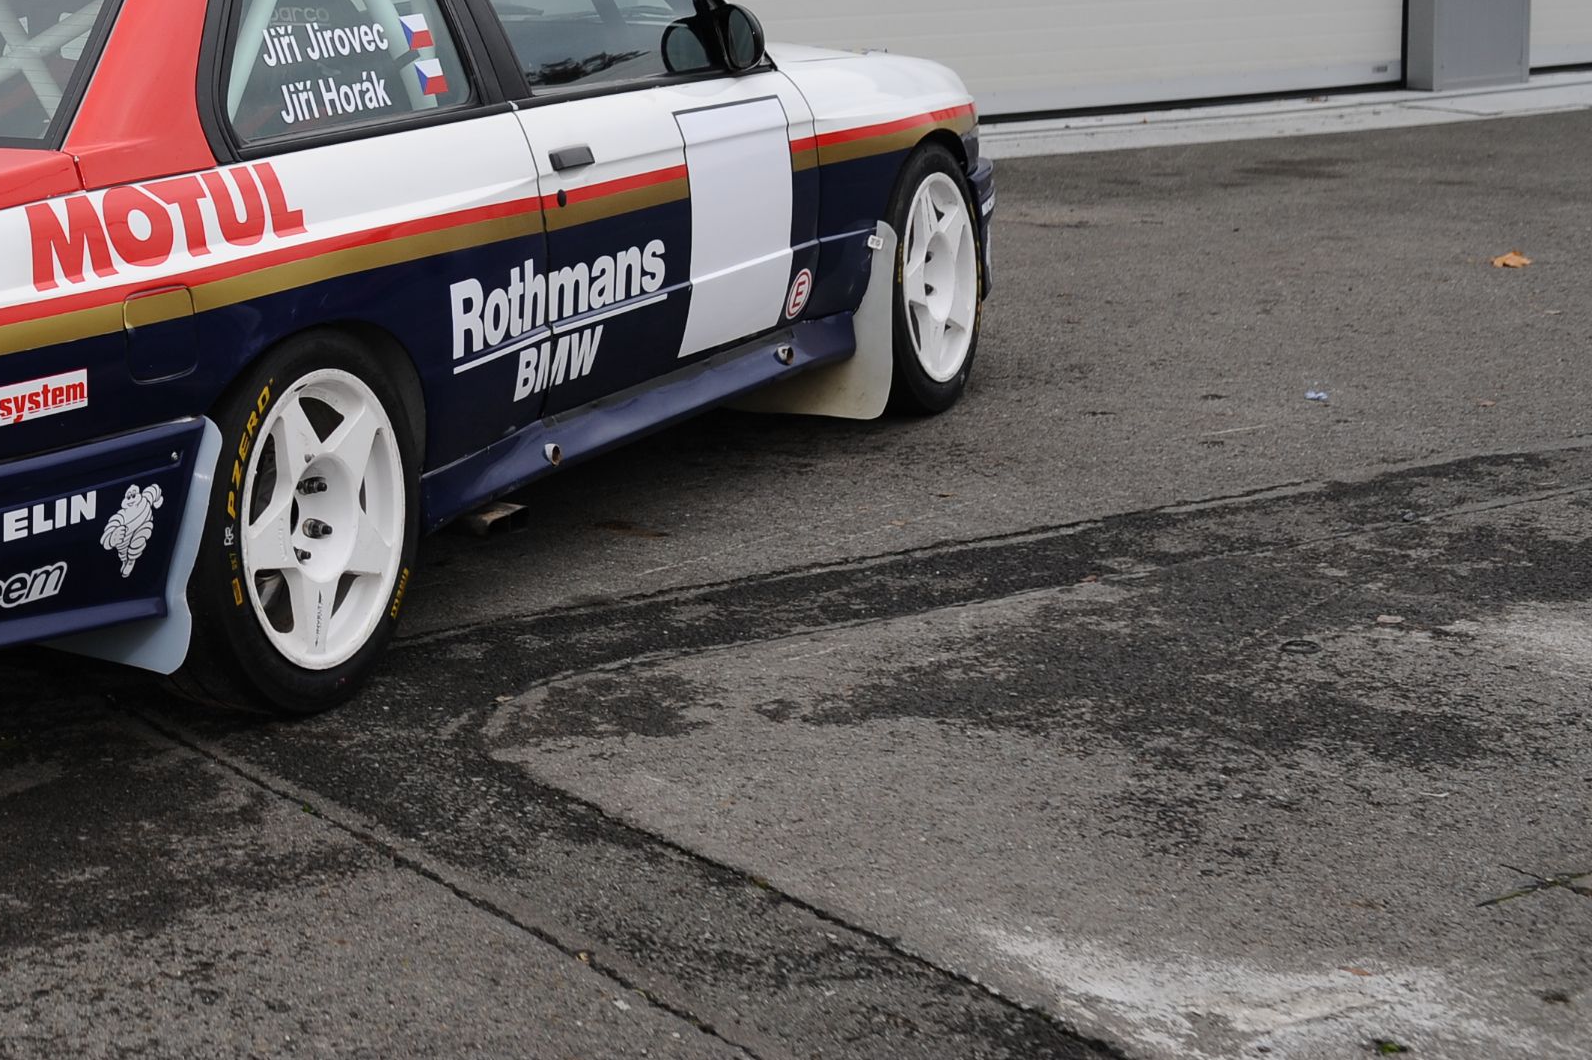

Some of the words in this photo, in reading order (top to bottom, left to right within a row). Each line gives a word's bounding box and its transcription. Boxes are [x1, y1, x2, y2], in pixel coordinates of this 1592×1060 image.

[262, 25, 302, 67] Jiří
[306, 22, 389, 60] Jirovec
[271, 6, 330, 22] arco
[281, 80, 320, 124] Jiří
[318, 71, 392, 117] Horák
[24, 162, 309, 292] MOTUL
[449, 239, 666, 360] Rothmans
[513, 324, 604, 403] BMW
